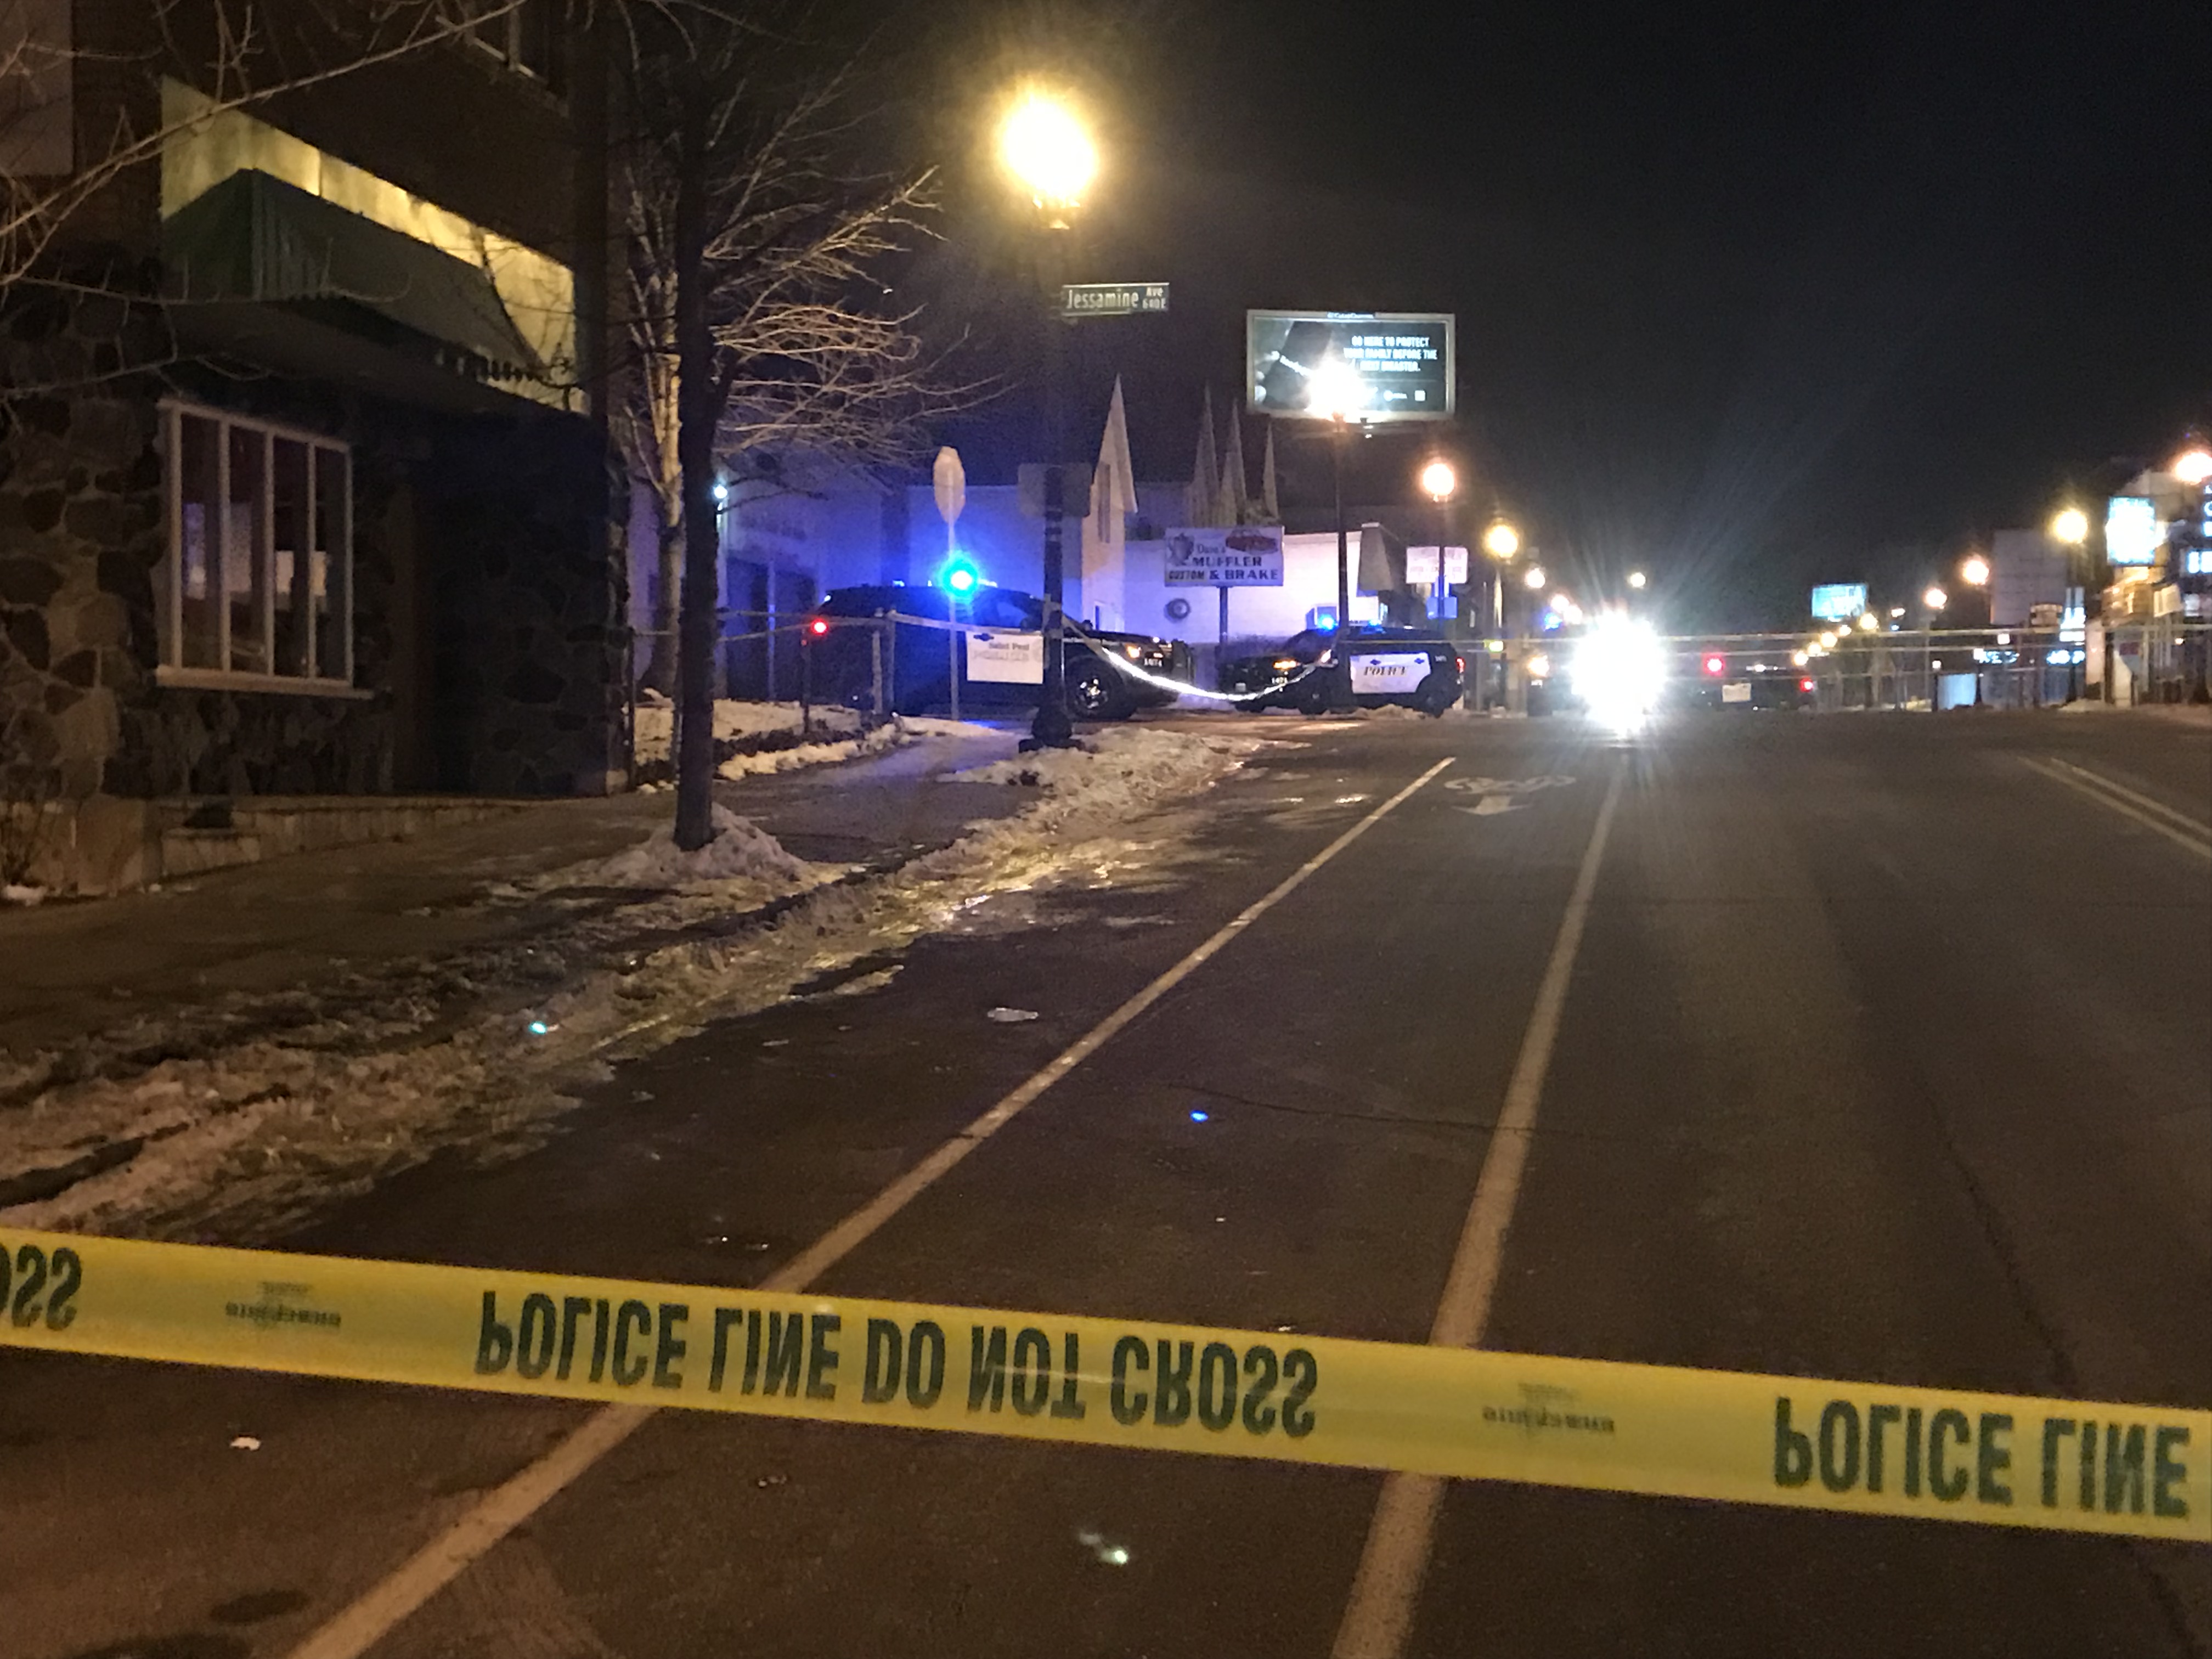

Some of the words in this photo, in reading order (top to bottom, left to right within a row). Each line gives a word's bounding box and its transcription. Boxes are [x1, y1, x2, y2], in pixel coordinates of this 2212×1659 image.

[1146, 287, 1163, 297] Ave
[1066, 288, 1139, 309] Jessamine
[1396, 336, 1430, 347] PROTECT
[1192, 556, 1262, 567] MUFFLER
[1209, 569, 1220, 580] &
[1224, 569, 1278, 580] BRAKE
